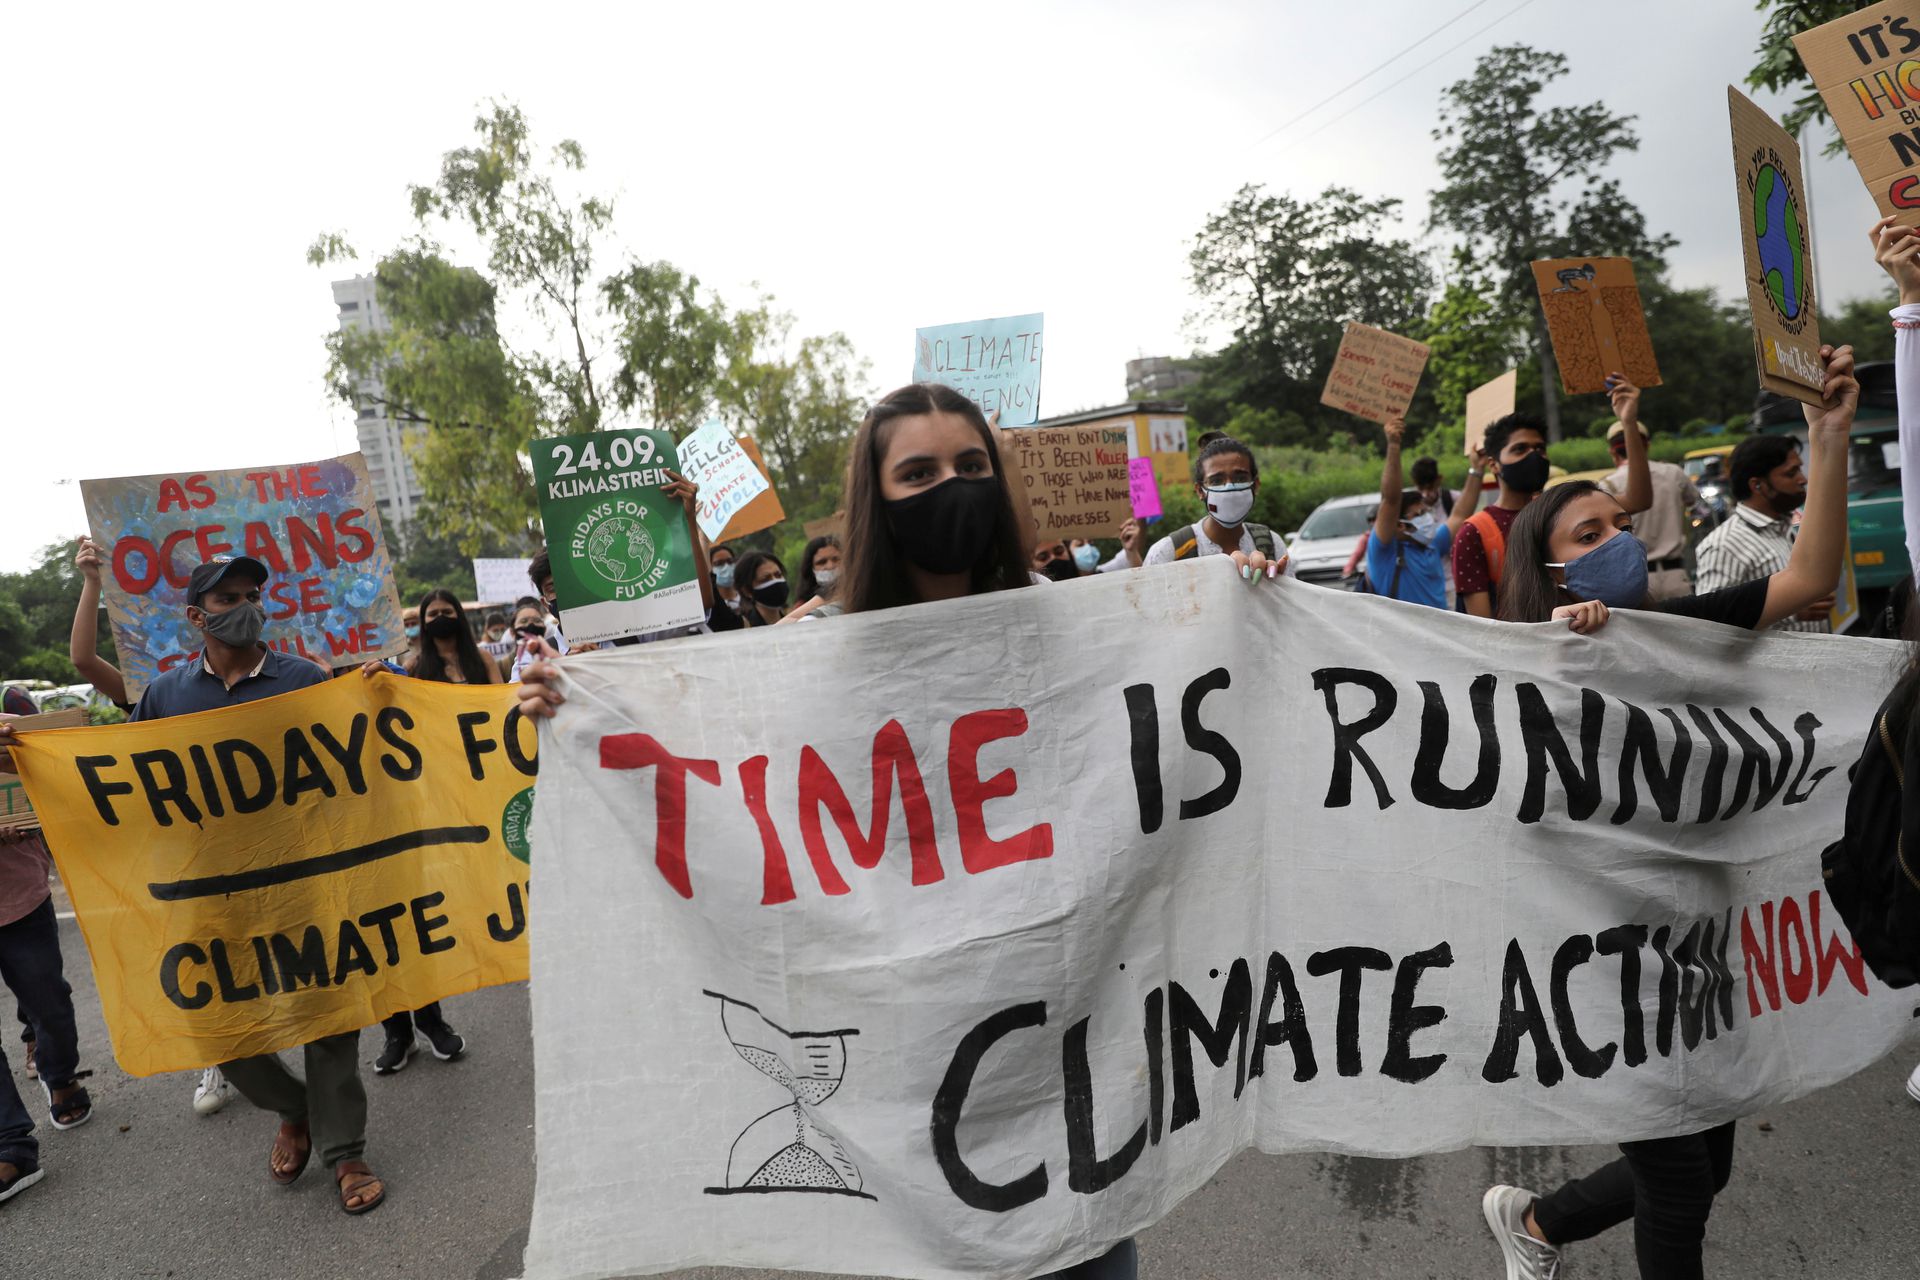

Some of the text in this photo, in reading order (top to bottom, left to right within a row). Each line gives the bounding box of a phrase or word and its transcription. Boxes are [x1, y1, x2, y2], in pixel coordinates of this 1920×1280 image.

[1847, 16, 1920, 65] IT'S
[1849, 59, 1920, 120] HO
[1752, 146, 1766, 172] YOU
[1777, 312, 1803, 335] SHOULD
[935, 332, 1041, 373] CLIMATE
[551, 435, 664, 477] 24.09.
[1014, 434, 1032, 448] THE
[1038, 432, 1070, 446] EARTH
[1102, 429, 1128, 446] DYING
[1053, 447, 1091, 467] BEEN
[1095, 448, 1129, 466] KILLED
[548, 467, 673, 500] KLIMASTREIK
[683, 450, 719, 481] ILL
[1040, 472, 1073, 488] THOSE
[1079, 469, 1104, 485] WHO
[1107, 468, 1127, 480] ARE
[157, 466, 329, 513] AS THE
[703, 473, 747, 519] CLIMATE
[1075, 489, 1102, 504] HAVE
[1105, 487, 1130, 501] NAME
[572, 501, 648, 558] FRIDAYS FOR
[1046, 510, 1110, 529] ADDRESSES
[112, 508, 375, 595] OCEANS
[615, 558, 669, 599] FUTURE
[325, 623, 383, 656] WE
[75, 703, 539, 829] FRIDAYS FO
[600, 667, 1837, 905] TIME IS RUNNING
[506, 800, 527, 850] FRIDAYS
[160, 892, 456, 1010] CLIMATE
[930, 889, 1869, 1213] CLIMATE ACTION NOW
